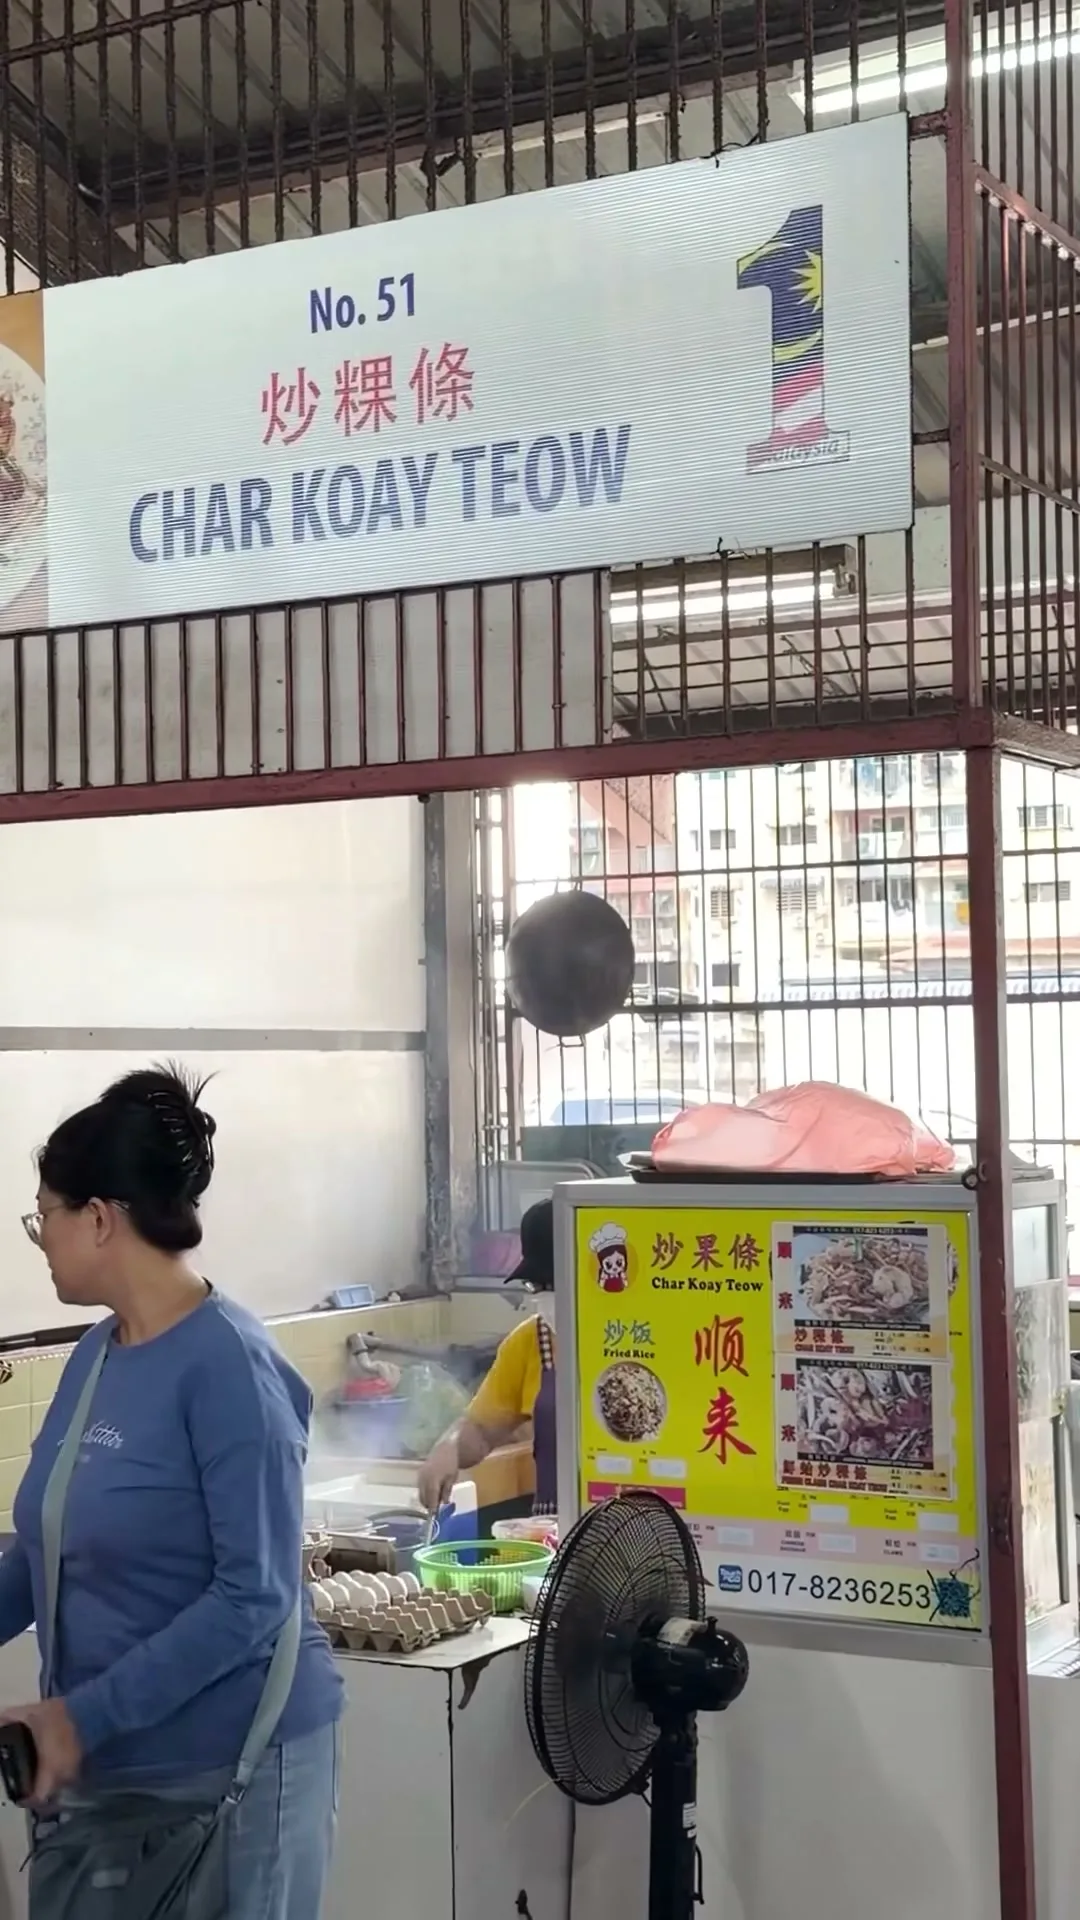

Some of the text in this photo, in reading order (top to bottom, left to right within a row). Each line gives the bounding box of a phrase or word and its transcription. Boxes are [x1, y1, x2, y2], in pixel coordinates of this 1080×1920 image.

[309, 272, 416, 334] No. 51
[261, 342, 476, 446] 炒粿條
[129, 424, 632, 563] CHAR KOAY TEOW
[651, 1232, 764, 1272] 炒果條
[651, 1276, 764, 1293] Char Koay Teow
[603, 1319, 656, 1347] 炒饭
[603, 1348, 656, 1359] Fried Rice
[748, 1569, 931, 1609] 017-8236253
